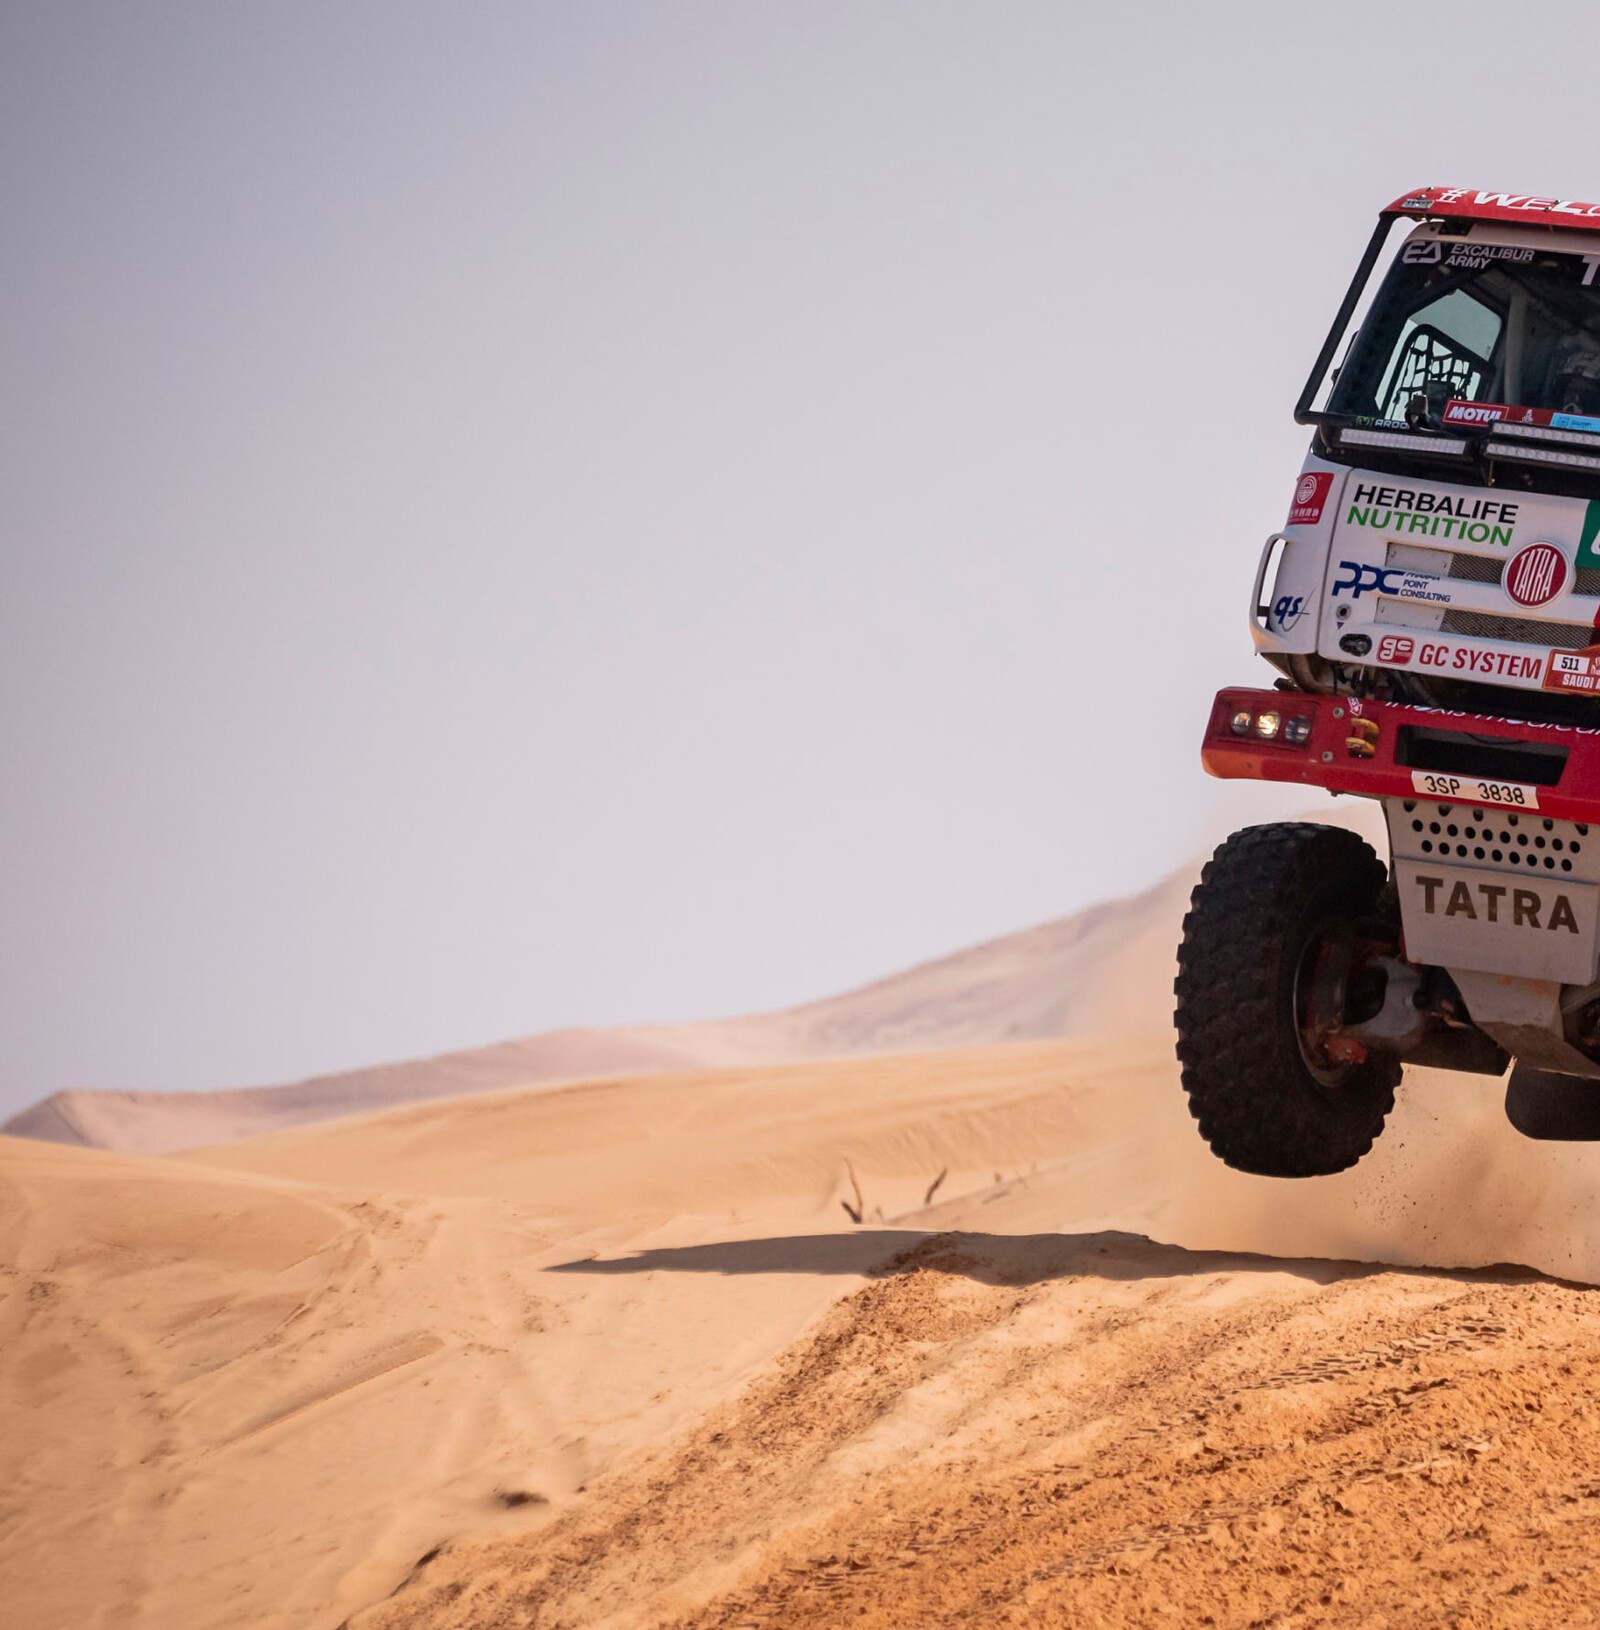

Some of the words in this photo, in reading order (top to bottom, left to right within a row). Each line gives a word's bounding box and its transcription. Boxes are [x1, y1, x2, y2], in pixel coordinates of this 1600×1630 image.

[1444, 254, 1491, 269] ARMY
[1450, 243, 1536, 262] EXCALIBUR
[1353, 484, 1519, 525] HERBALIFE
[1347, 506, 1514, 547] NUTRITION
[1403, 579, 1430, 590] POINT
[1514, 549, 1561, 603] TATRA
[1400, 590, 1451, 603] CONSULTING
[1419, 644, 1449, 667] GC
[1452, 648, 1542, 680] SYSTEM
[1561, 656, 1580, 671] 511
[1562, 673, 1594, 689] SAUDI
[1424, 775, 1460, 796] 3SP
[1477, 782, 1525, 806] 3838
[1415, 875, 1580, 935] TATRA
